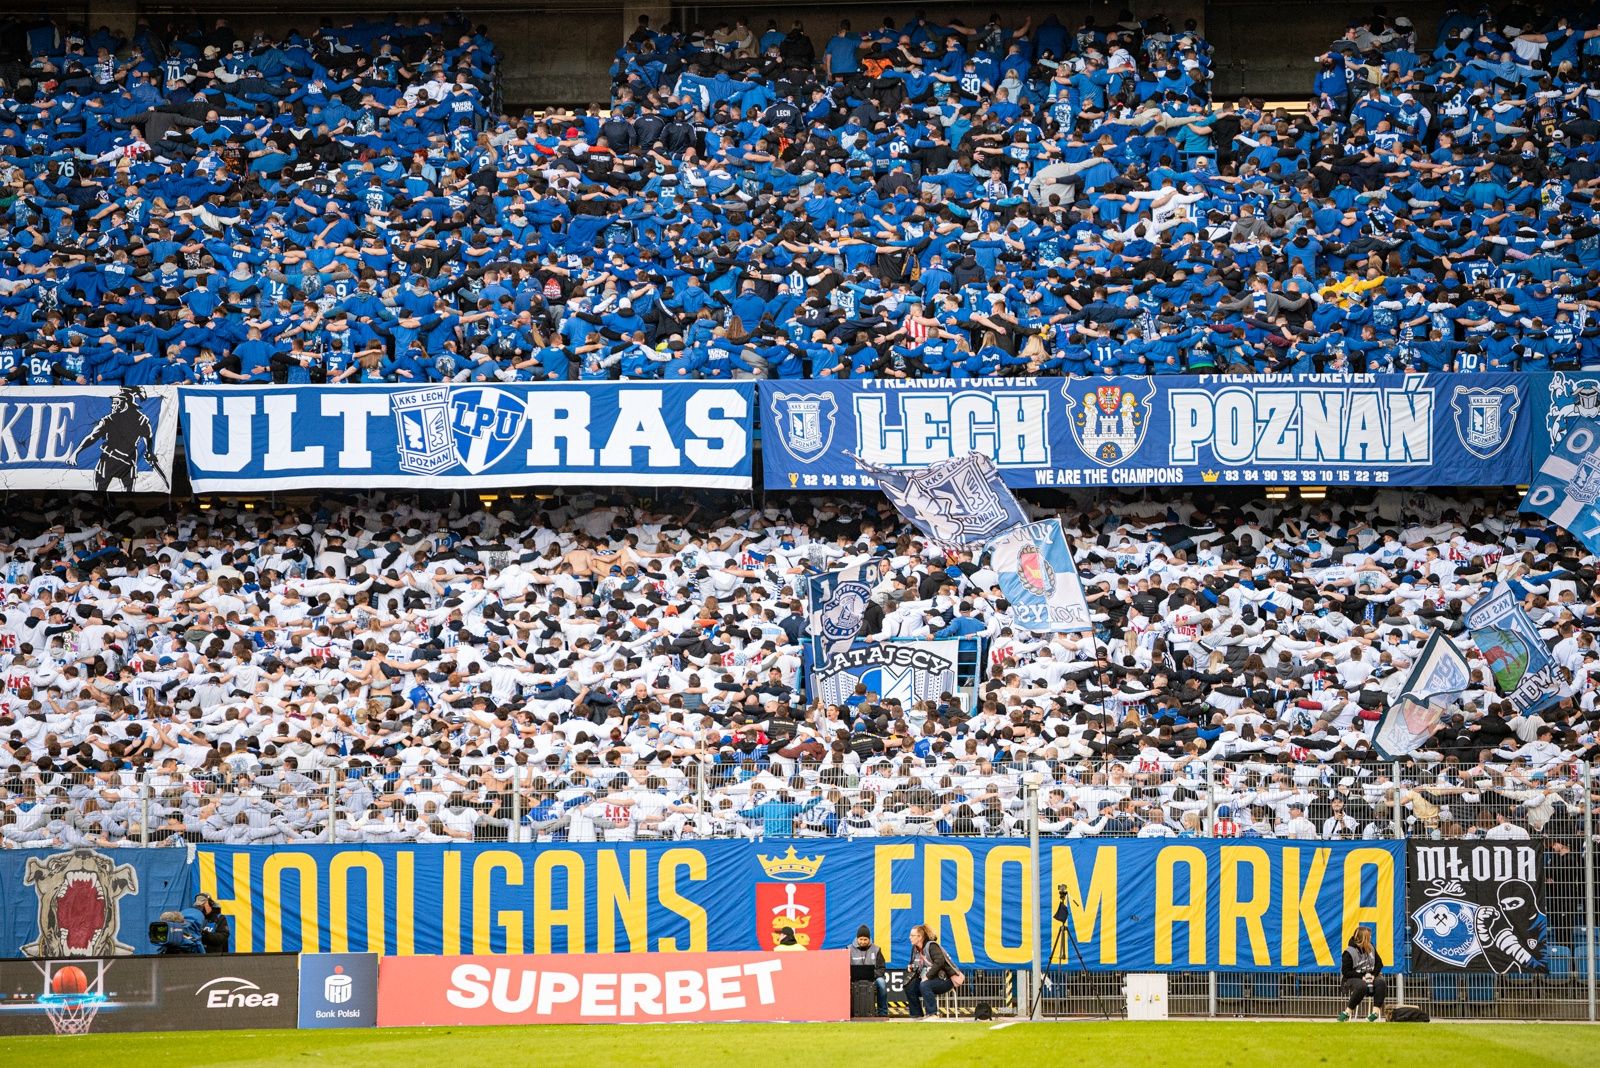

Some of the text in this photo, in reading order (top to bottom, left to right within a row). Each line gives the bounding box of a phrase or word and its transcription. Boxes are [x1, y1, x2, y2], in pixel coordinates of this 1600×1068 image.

[961, 79, 980, 96] 30
[776, 111, 791, 119] LECH
[58, 161, 75, 178] 76
[661, 187, 675, 198] 22
[337, 284, 347, 298] 9
[789, 274, 804, 291] 10
[1097, 346, 1111, 360] 11
[1462, 354, 1478, 369] 10
[31, 358, 51, 375] 64
[961, 377, 1037, 390] FOREVER
[1299, 372, 1376, 384] FOREVER
[398, 391, 444, 405] KKS LECH
[452, 401, 523, 440] LPU
[853, 373, 1435, 471] LECH POZNAŃ
[925, 471, 944, 488] KKS
[1036, 468, 1183, 484] WE ARE THE CHAMPIONS
[819, 645, 951, 681] ATAJSCY
[606, 804, 630, 819] ŁKS
[1416, 846, 1536, 882] MŁODA
[198, 848, 707, 957] HOOLIGANS
[874, 843, 1395, 967] FROM ARKA
[446, 958, 783, 1017] SUPERBET
[206, 988, 279, 1009] Enea
[316, 1009, 361, 1018] Bank Polski
